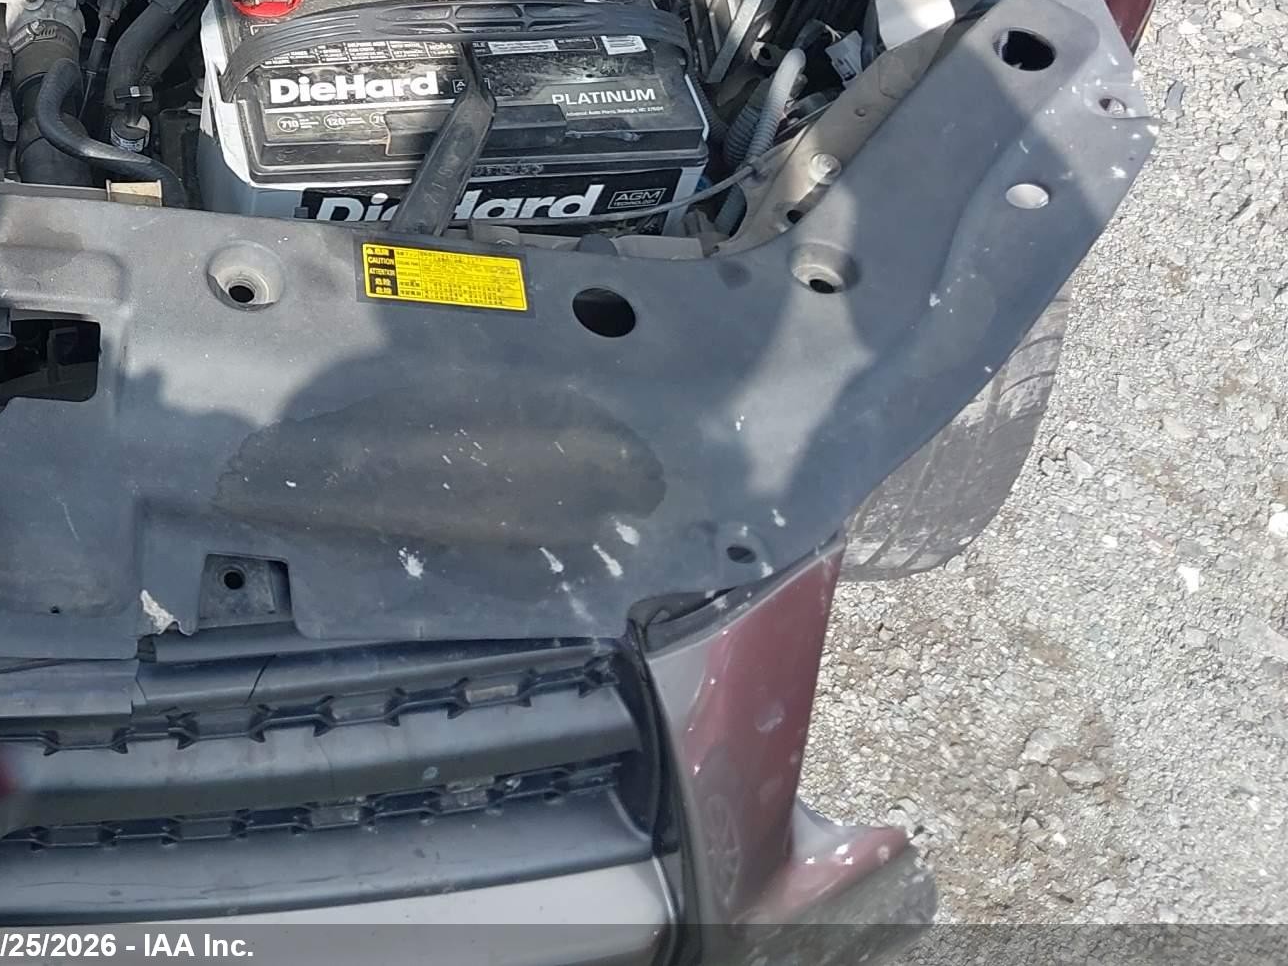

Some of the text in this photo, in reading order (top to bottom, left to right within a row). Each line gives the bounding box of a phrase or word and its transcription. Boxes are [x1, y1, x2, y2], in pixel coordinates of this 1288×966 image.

[269, 71, 439, 104] DieHard
[552, 88, 656, 105] PLATINUM
[615, 190, 662, 202] AGM
[367, 256, 395, 265] CAUTION
